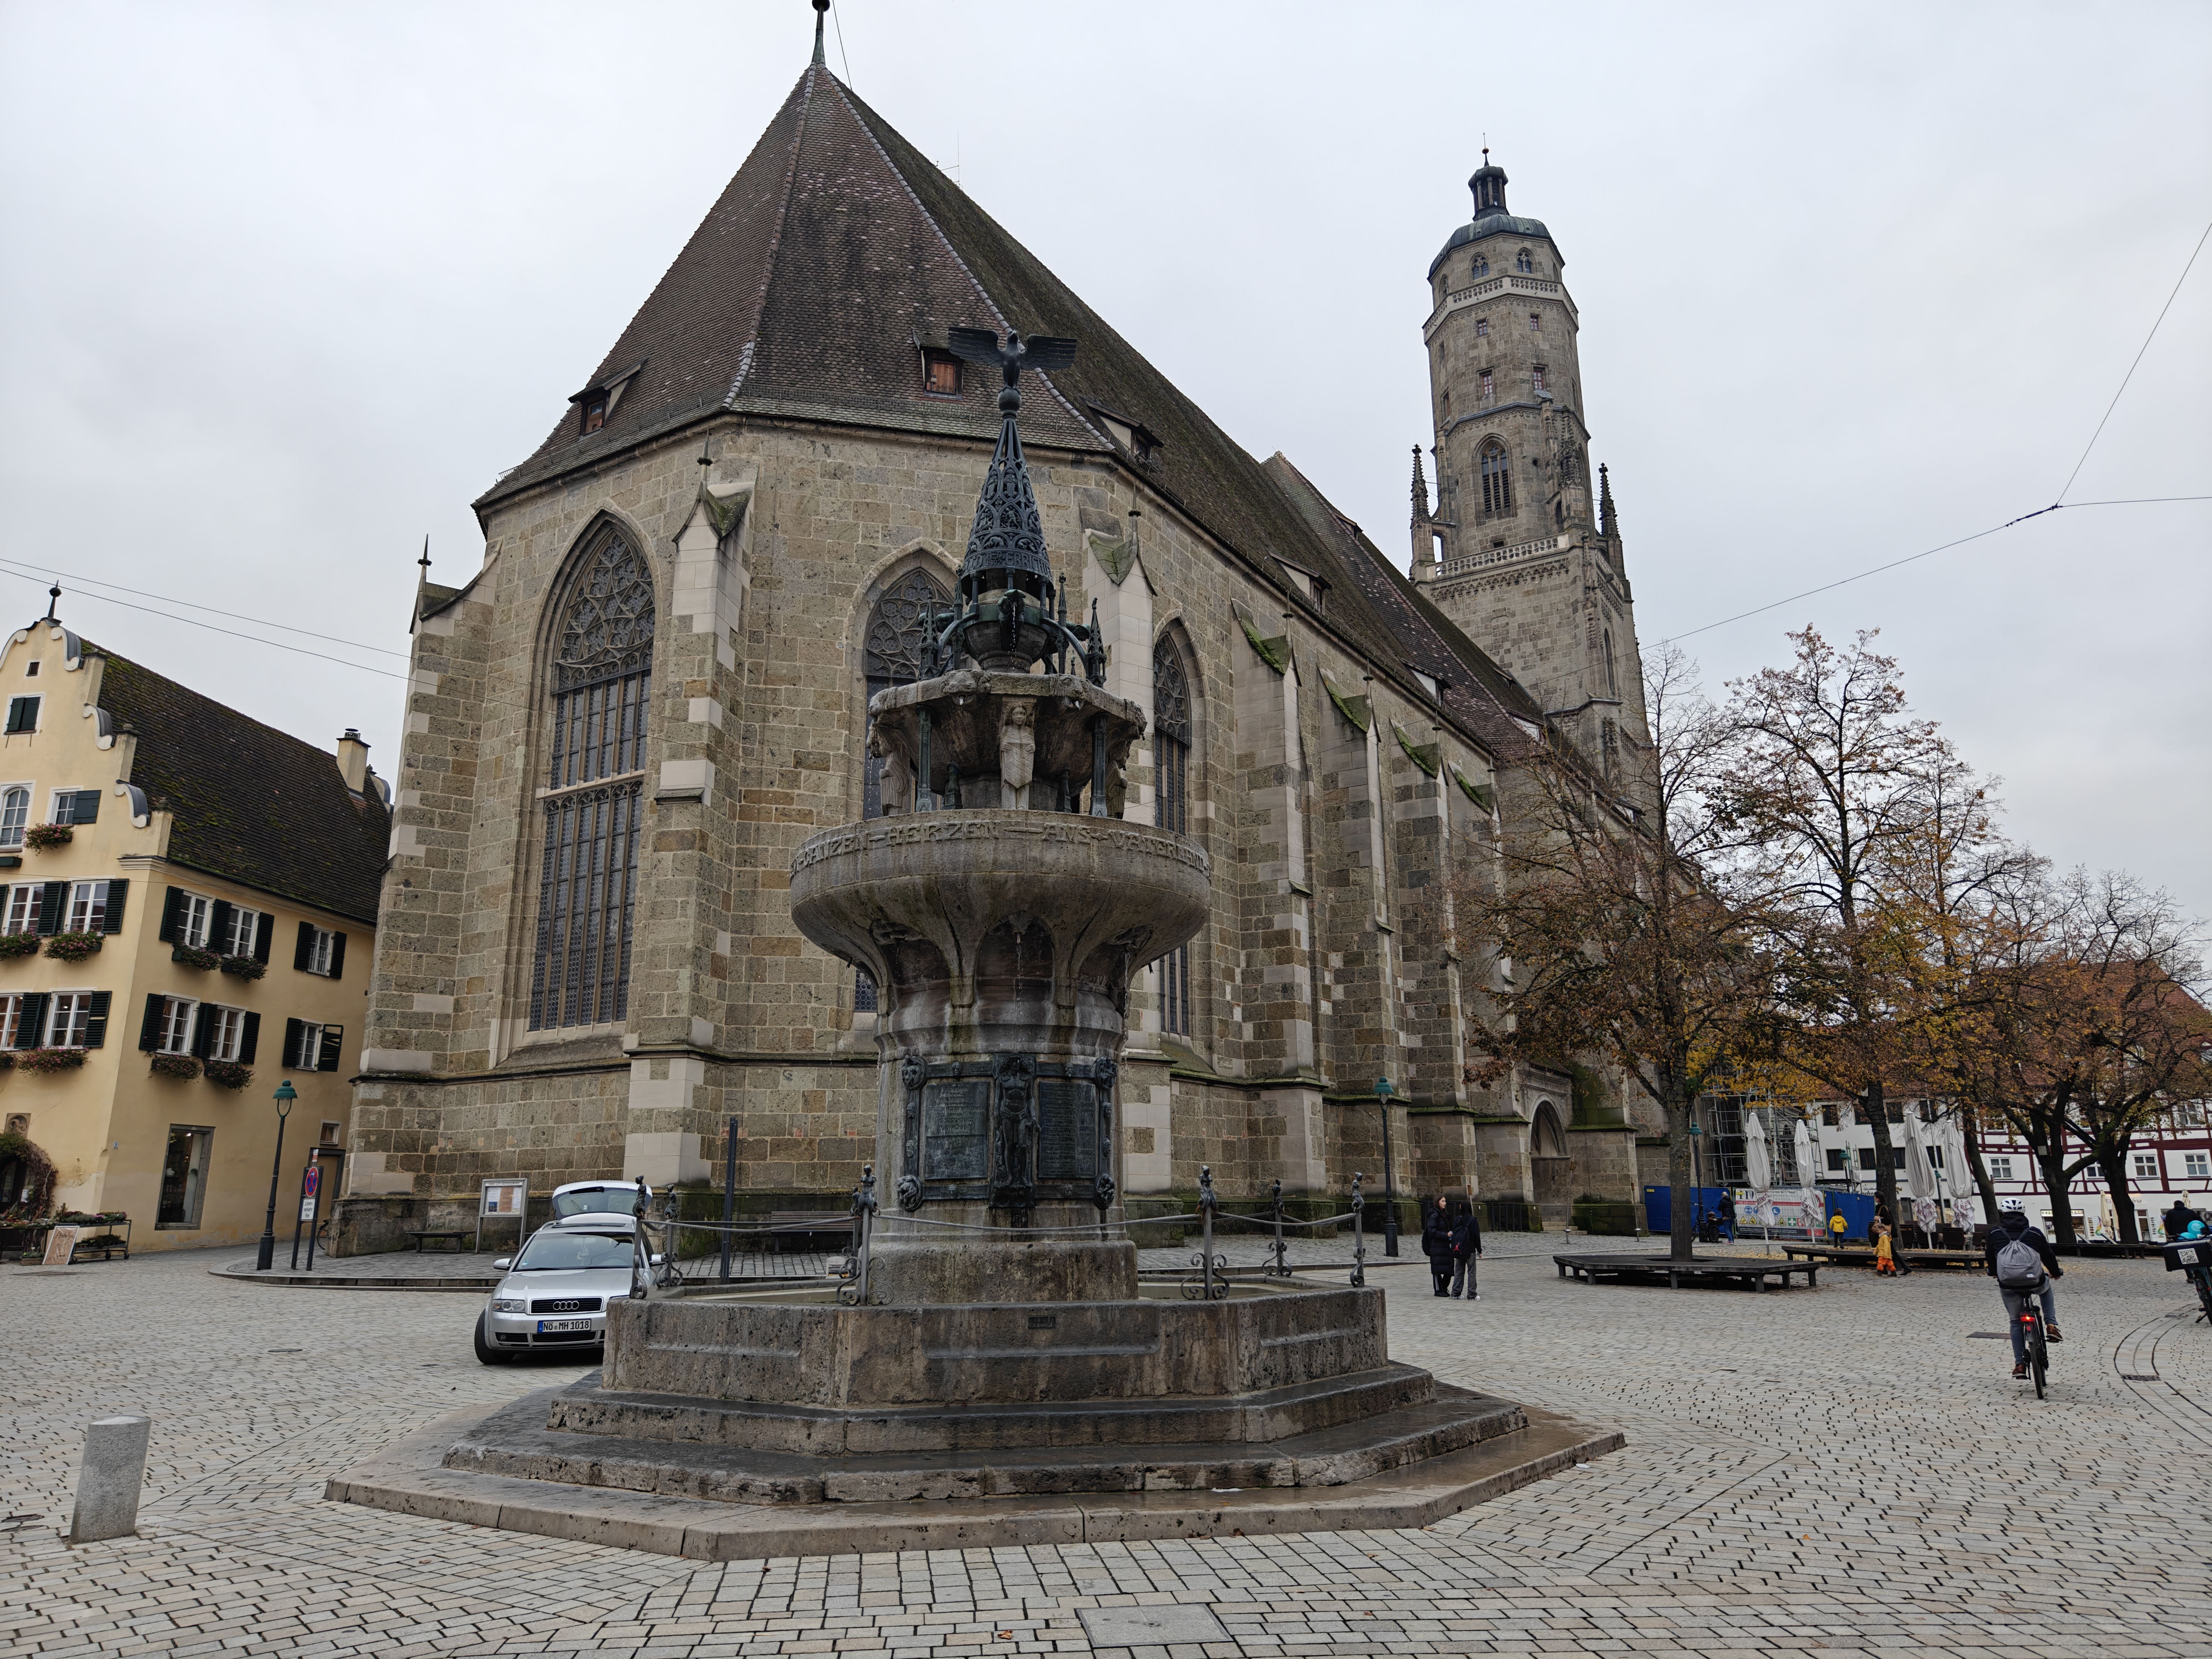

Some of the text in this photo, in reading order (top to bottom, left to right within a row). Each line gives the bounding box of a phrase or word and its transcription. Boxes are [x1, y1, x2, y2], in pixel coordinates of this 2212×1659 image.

[887, 822, 999, 846] HERZEN
[1041, 822, 1090, 843] ANS
[543, 1322, 553, 1331] NÖ
[559, 1322, 569, 1330] MH
[570, 1321, 589, 1330] 1018
